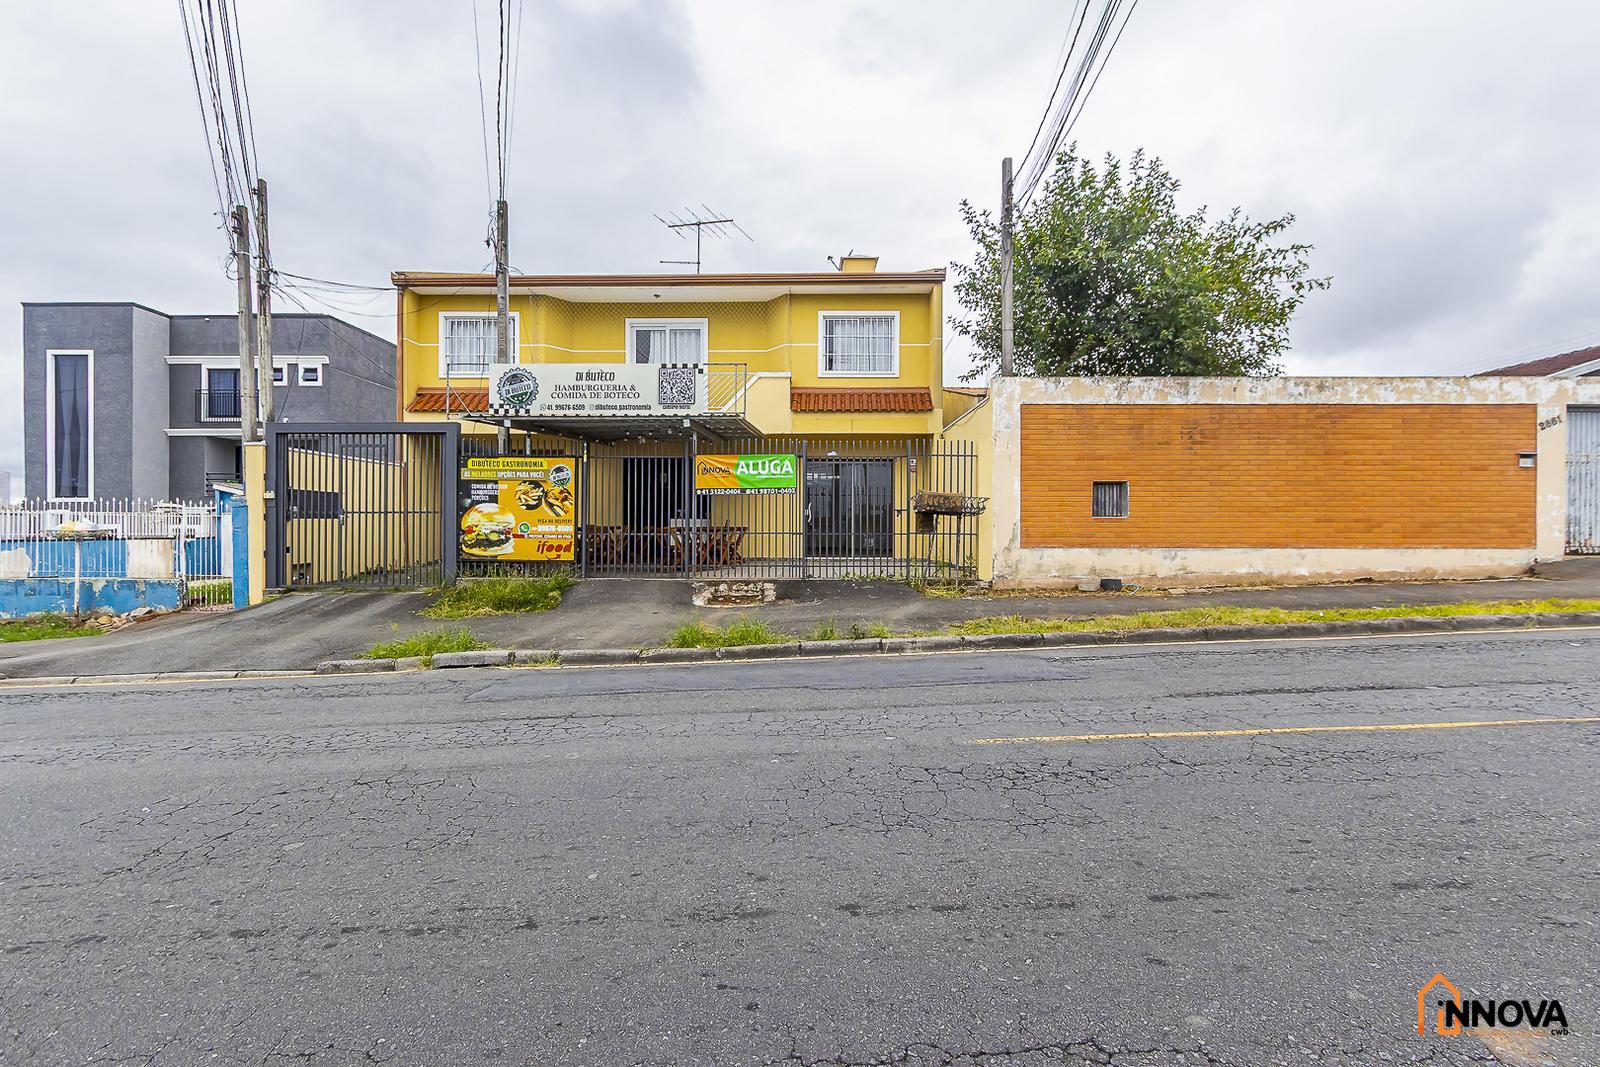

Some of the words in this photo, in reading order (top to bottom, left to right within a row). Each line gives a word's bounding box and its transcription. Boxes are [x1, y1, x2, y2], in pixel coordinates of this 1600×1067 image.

[554, 384, 628, 392] HAMBURGUERIA
[629, 384, 636, 392] &
[550, 391, 587, 399] COMIDA
[589, 391, 603, 399] DE
[603, 391, 640, 399] BOTECO
[502, 460, 544, 468] GASTRONOMIA
[736, 460, 794, 475] ALUGA
[497, 470, 516, 478] OPÇÕES
